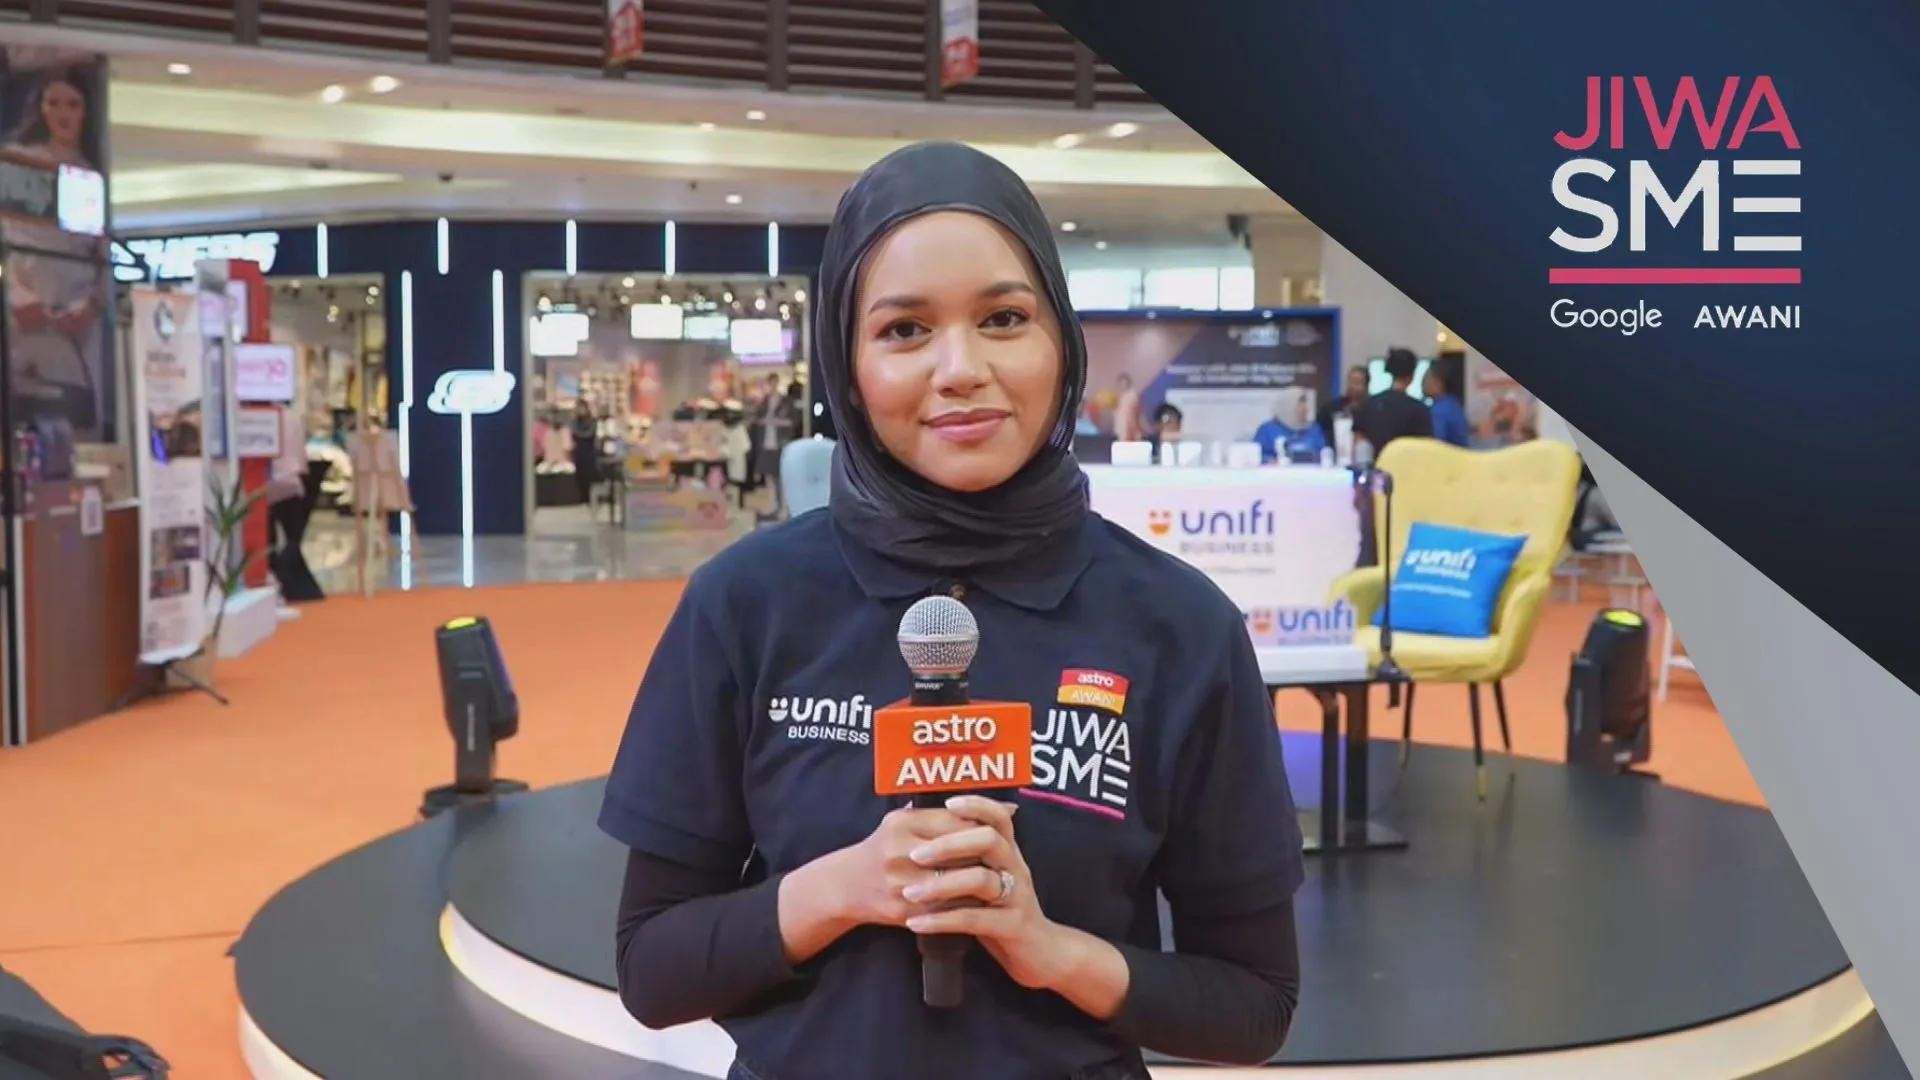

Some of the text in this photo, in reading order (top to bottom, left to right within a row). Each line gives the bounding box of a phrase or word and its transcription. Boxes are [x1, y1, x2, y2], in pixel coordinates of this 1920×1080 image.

[1180, 499, 1275, 536] unifi
[1278, 599, 1353, 632] unifi
[1078, 671, 1115, 687] astro
[790, 693, 873, 729] unifi
[912, 713, 997, 745] astro
[787, 725, 871, 746] BUSINESS
[1031, 708, 1132, 762] JIWA
[895, 751, 1016, 787] AWANI
[1031, 743, 1132, 807] SME
